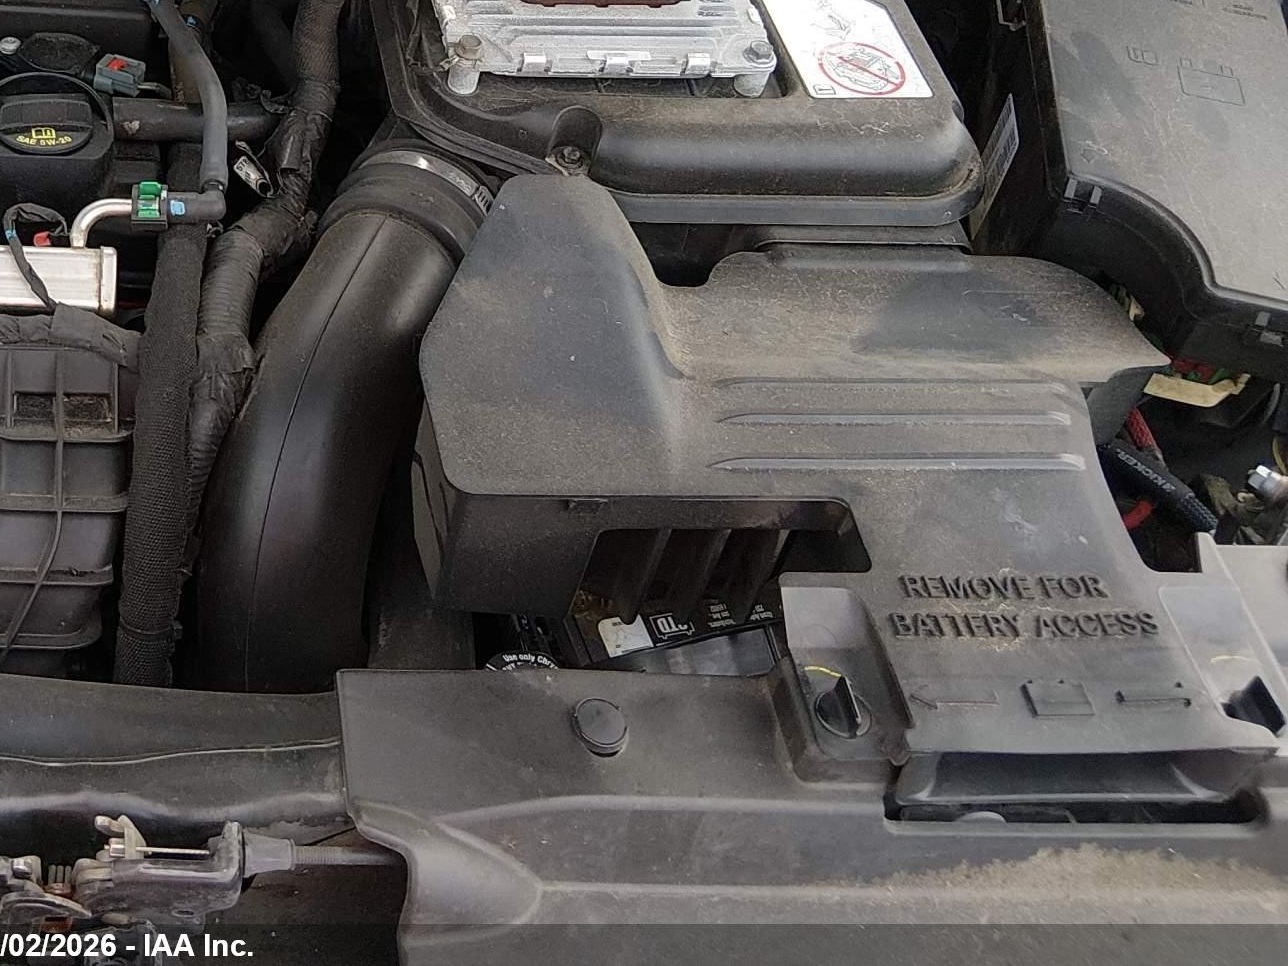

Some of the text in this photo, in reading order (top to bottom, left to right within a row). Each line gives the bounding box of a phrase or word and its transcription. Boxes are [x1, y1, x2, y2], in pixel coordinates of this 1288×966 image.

[16, 135, 72, 146] SAE 5W-20
[1116, 448, 1167, 487] KICKER
[898, 574, 1110, 600] REMOVE FOR
[889, 611, 1160, 638] BATTERY ACCESS
[502, 654, 518, 663] Use
[518, 653, 536, 663] only
